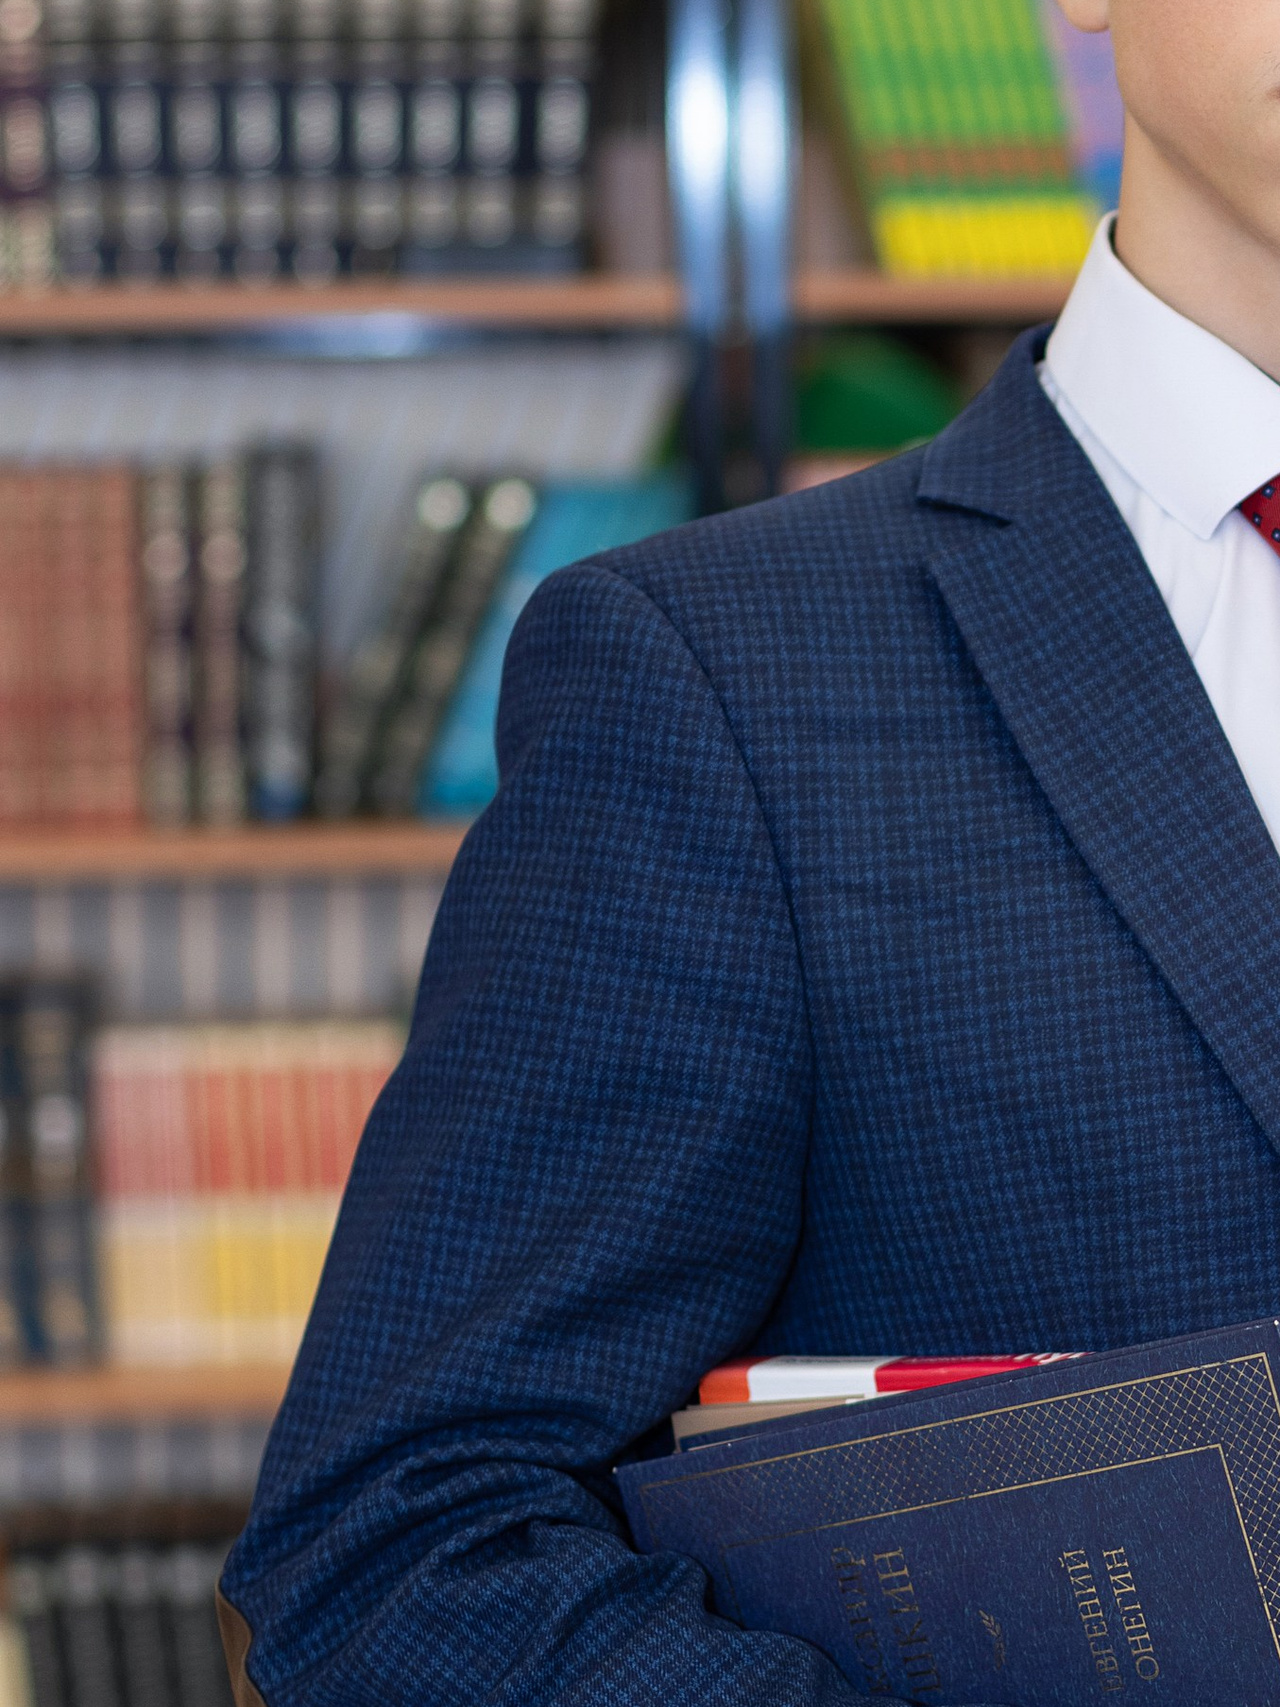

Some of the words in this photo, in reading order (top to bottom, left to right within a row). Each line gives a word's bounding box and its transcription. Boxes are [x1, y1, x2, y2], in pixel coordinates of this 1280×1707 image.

[873, 1546, 940, 1694] ШКИН
[1060, 1548, 1126, 1692] ЕВГЕНИЙ
[1102, 1546, 1161, 1681] ОНЕГИН
